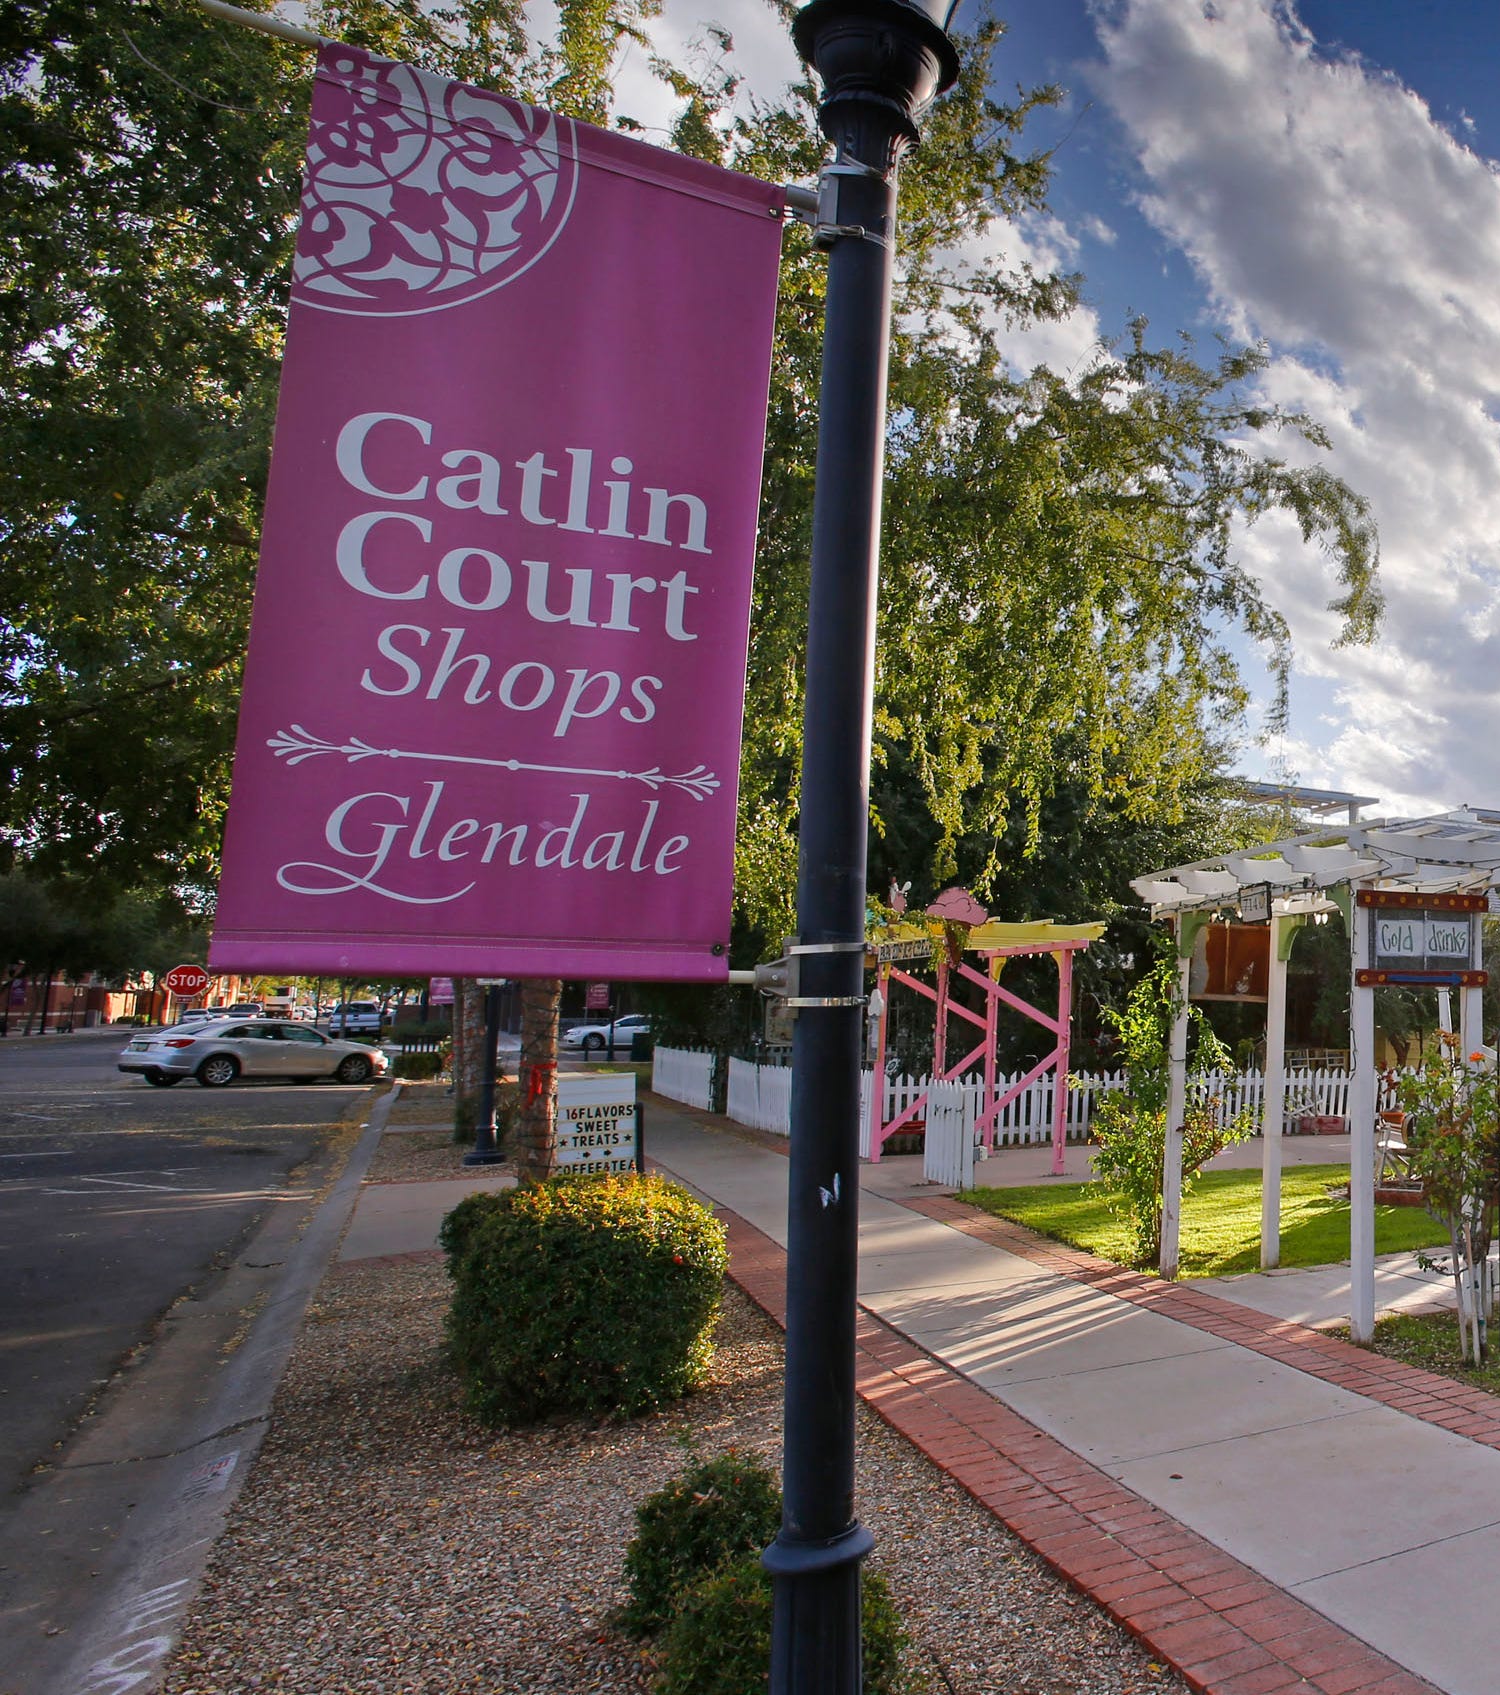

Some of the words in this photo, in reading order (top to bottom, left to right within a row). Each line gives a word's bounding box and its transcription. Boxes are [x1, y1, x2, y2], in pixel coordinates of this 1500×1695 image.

[335, 411, 712, 554] Catlin
[335, 510, 699, 641] Court
[360, 623, 663, 737] Shops
[276, 780, 689, 904] Glendale
[1428, 924, 1467, 952] drinks
[169, 974, 206, 987] STOP
[572, 1133, 620, 1147] TREATS
[576, 1120, 618, 1134] SWEET
